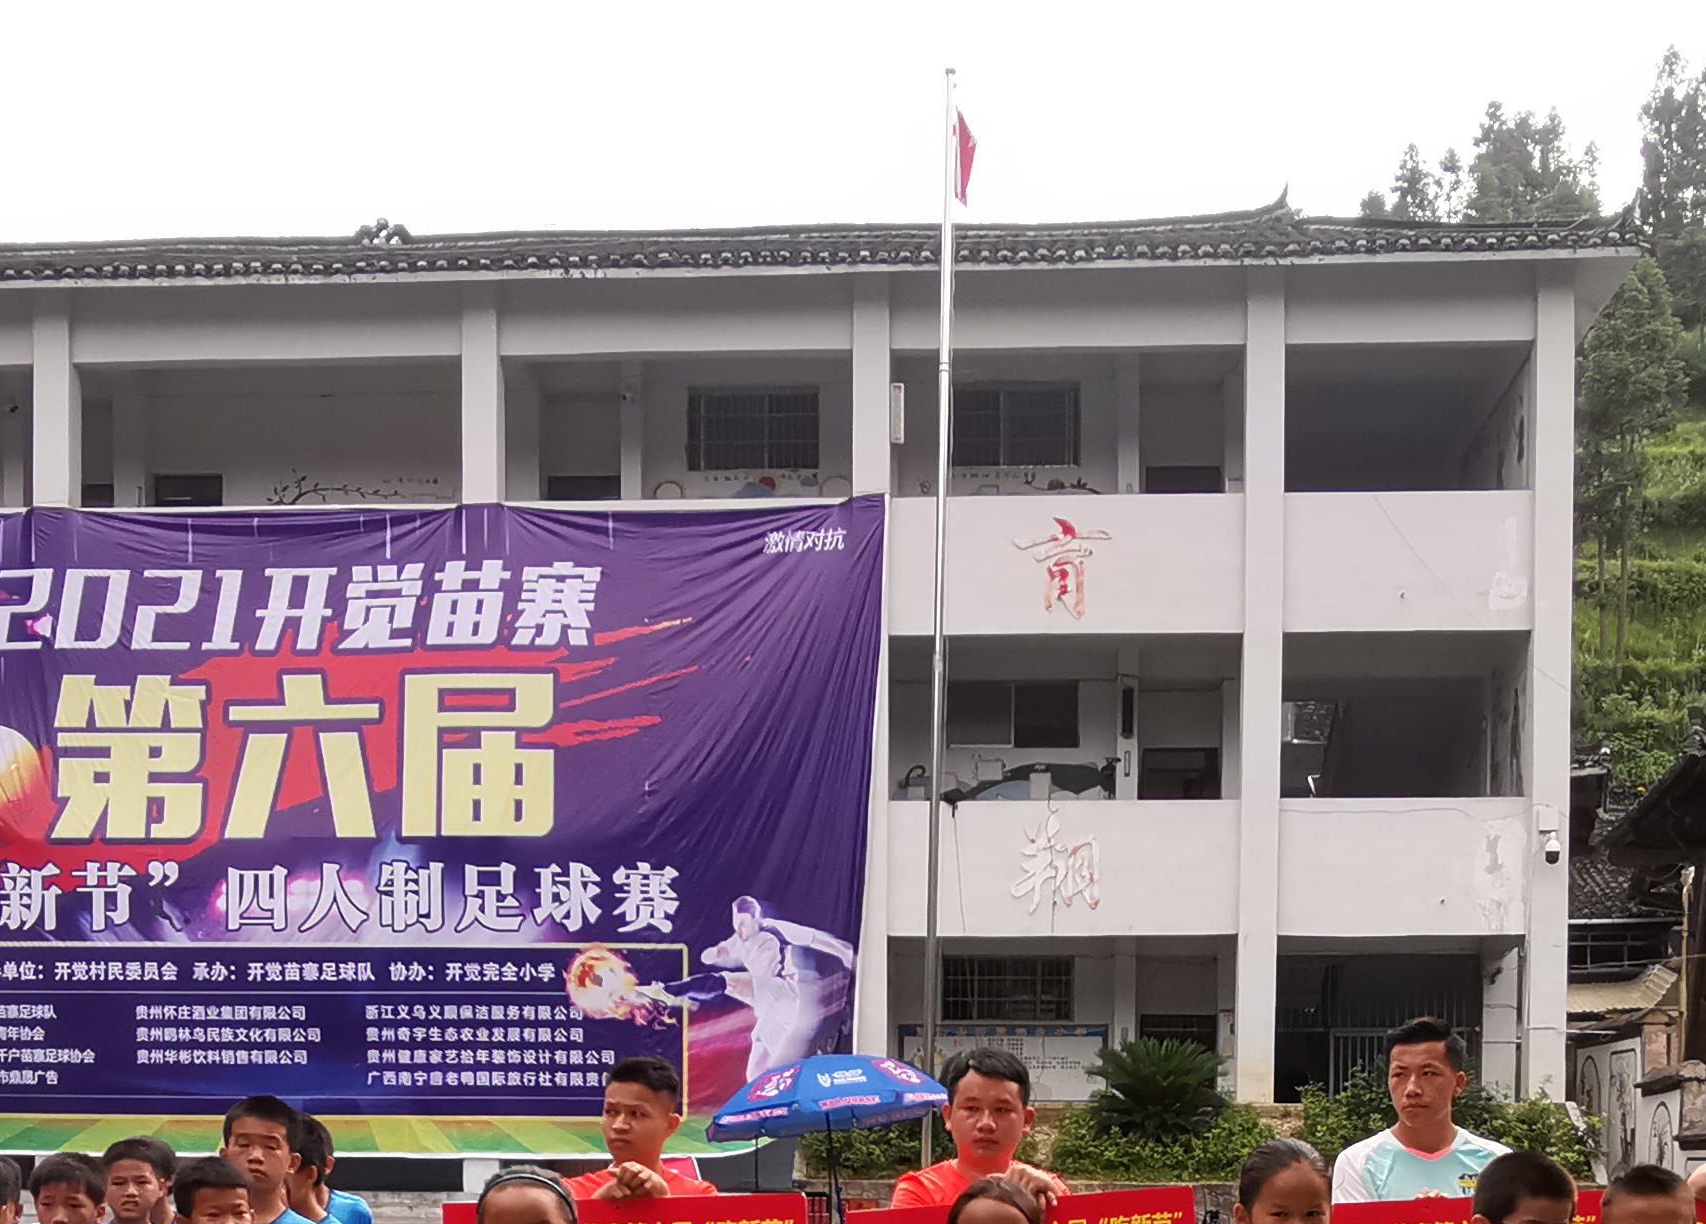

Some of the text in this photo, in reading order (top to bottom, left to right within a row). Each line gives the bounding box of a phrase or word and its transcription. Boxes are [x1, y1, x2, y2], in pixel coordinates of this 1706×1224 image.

[763, 527, 846, 554] 激情对抗
[1012, 516, 1111, 618] 育
[47, 671, 559, 840] 第六届
[227, 862, 681, 936] 四人制足球赛
